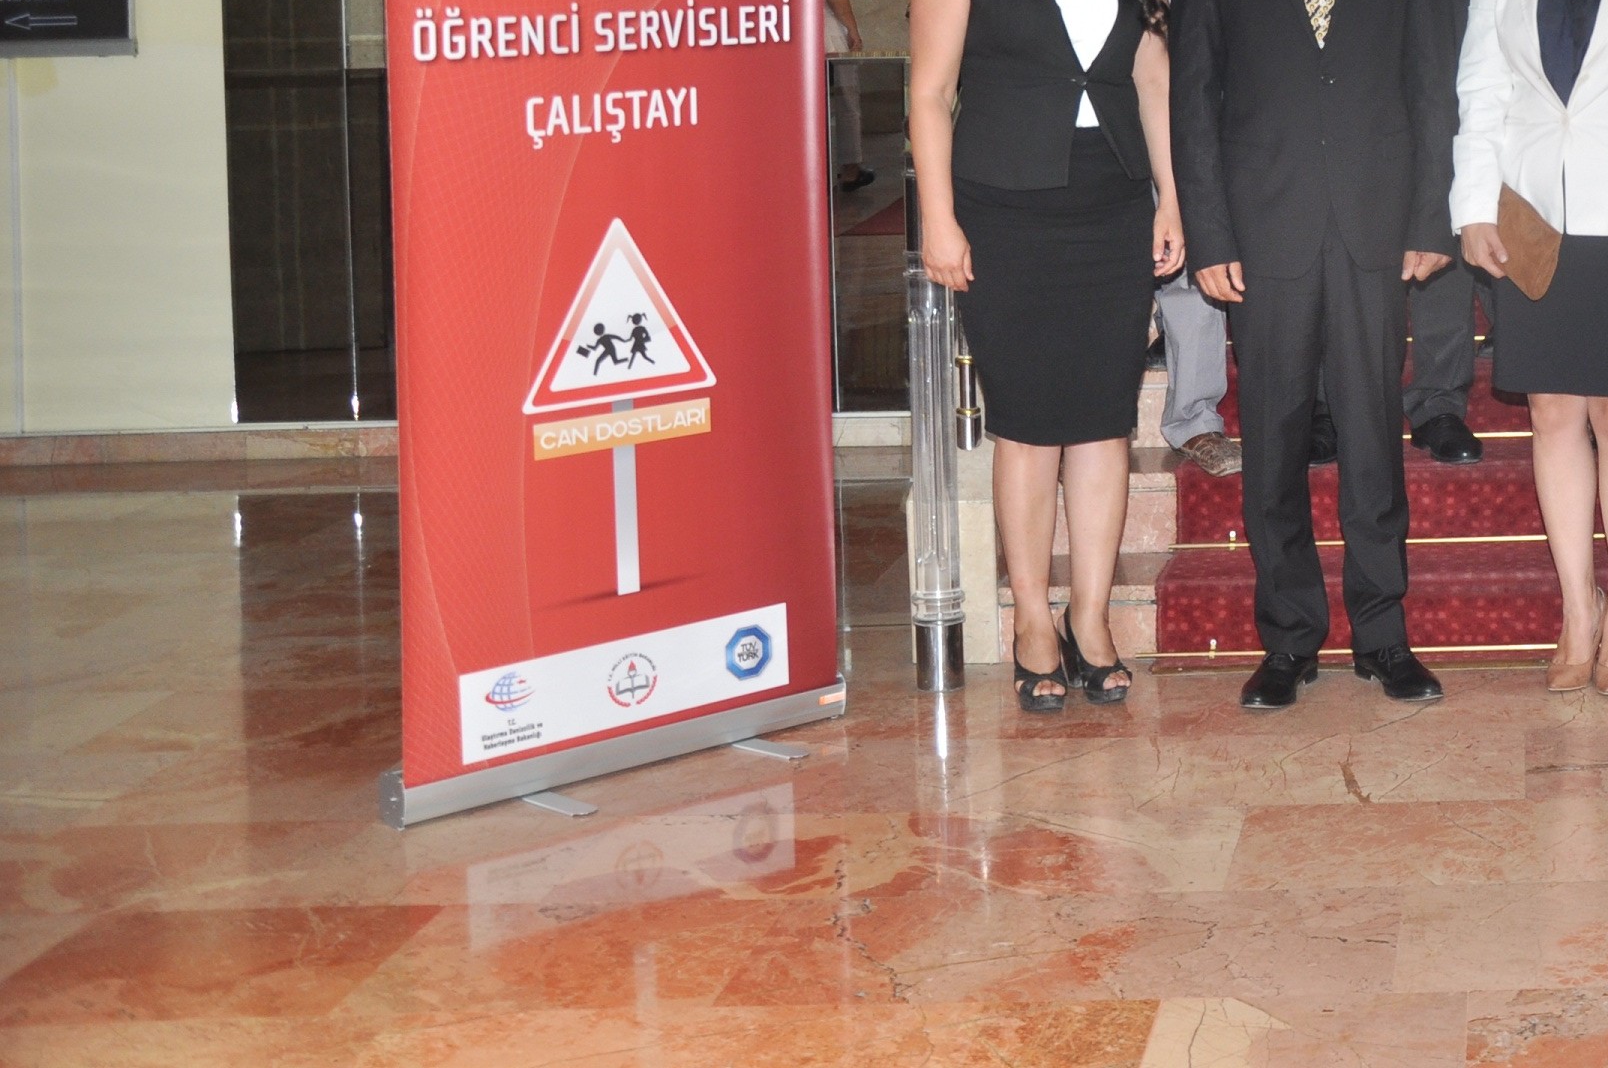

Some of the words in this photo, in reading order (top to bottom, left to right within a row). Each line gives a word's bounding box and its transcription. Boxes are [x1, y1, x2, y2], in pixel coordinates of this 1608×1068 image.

[412, 3, 579, 62] ÖĞRENCİ
[526, 86, 698, 150] ÇALIŞTAYI
[540, 426, 589, 450] CAN
[596, 407, 706, 442] DOSTLARI
